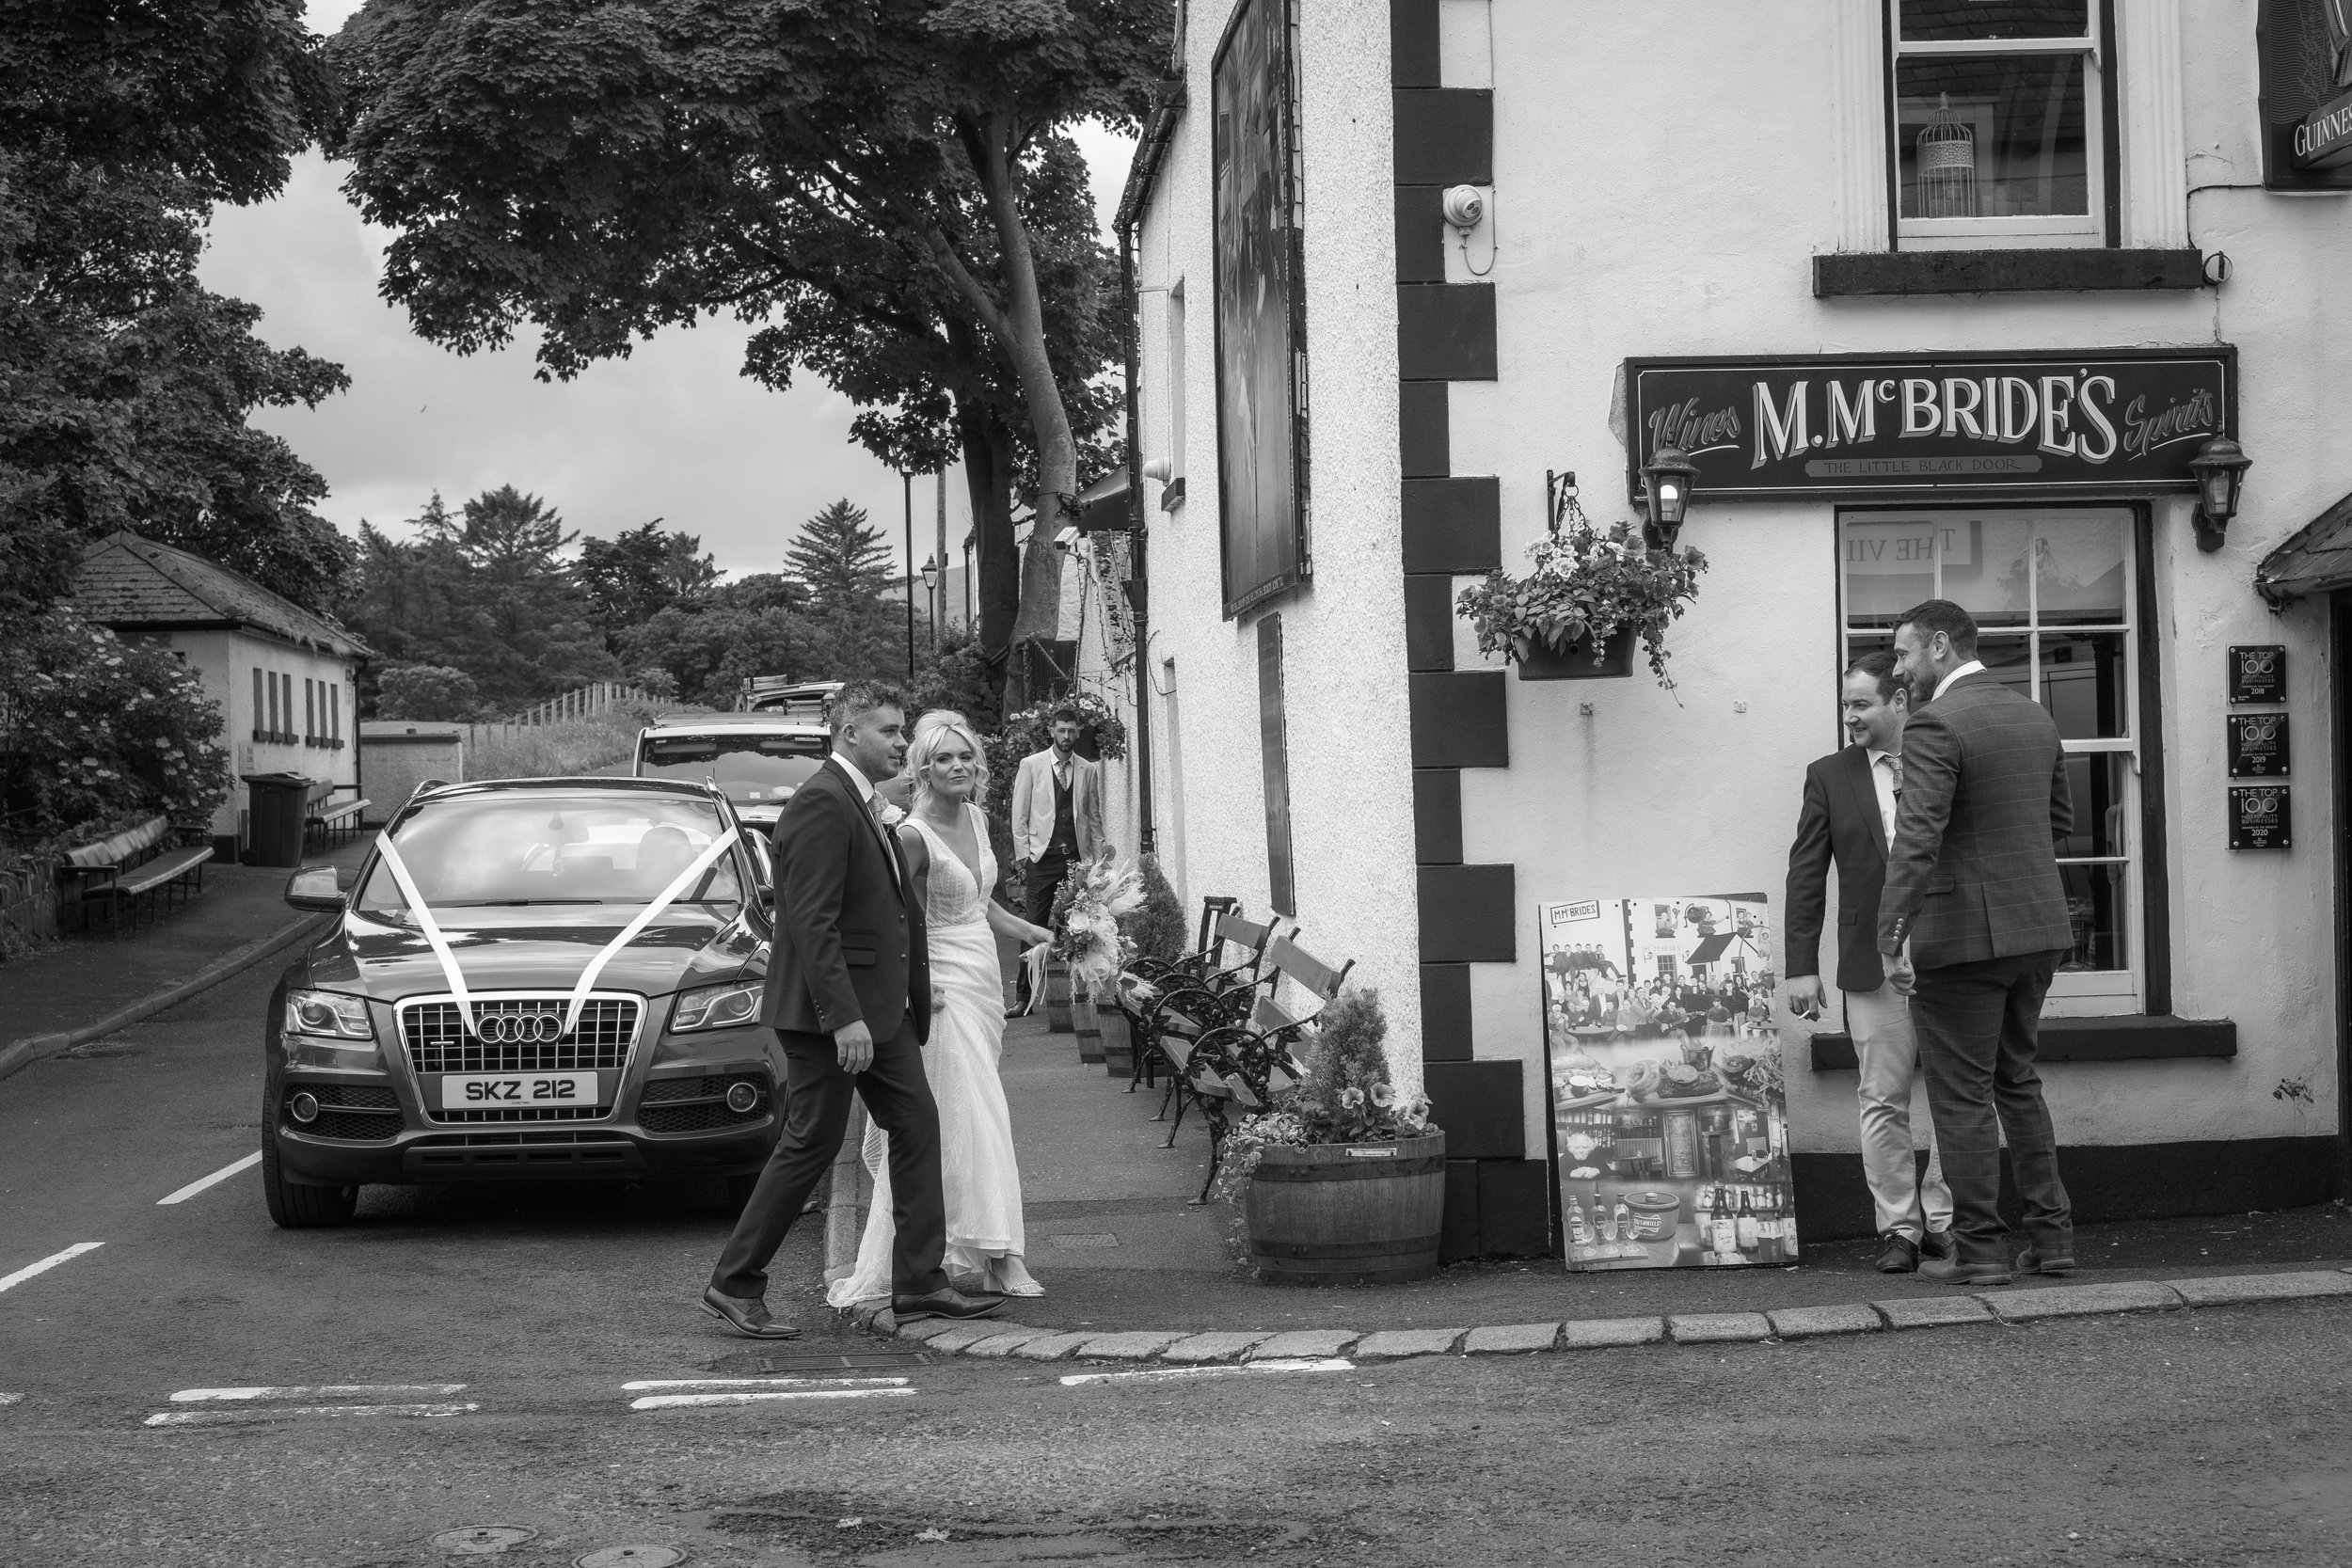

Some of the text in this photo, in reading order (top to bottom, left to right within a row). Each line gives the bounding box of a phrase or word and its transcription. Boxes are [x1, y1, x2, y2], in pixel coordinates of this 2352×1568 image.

[1648, 397, 1740, 452] Wines
[2123, 388, 2213, 456] Spirits
[1824, 457, 2023, 474] THE LITTLE BLACK DOOR
[2257, 651, 2274, 659] TOP
[2241, 659, 2274, 674] 100
[2241, 725, 2276, 741] 100
[2259, 788, 2278, 797] TOP
[2241, 798, 2278, 814] 100
[466, 1079, 575, 1101] SKZ 212
